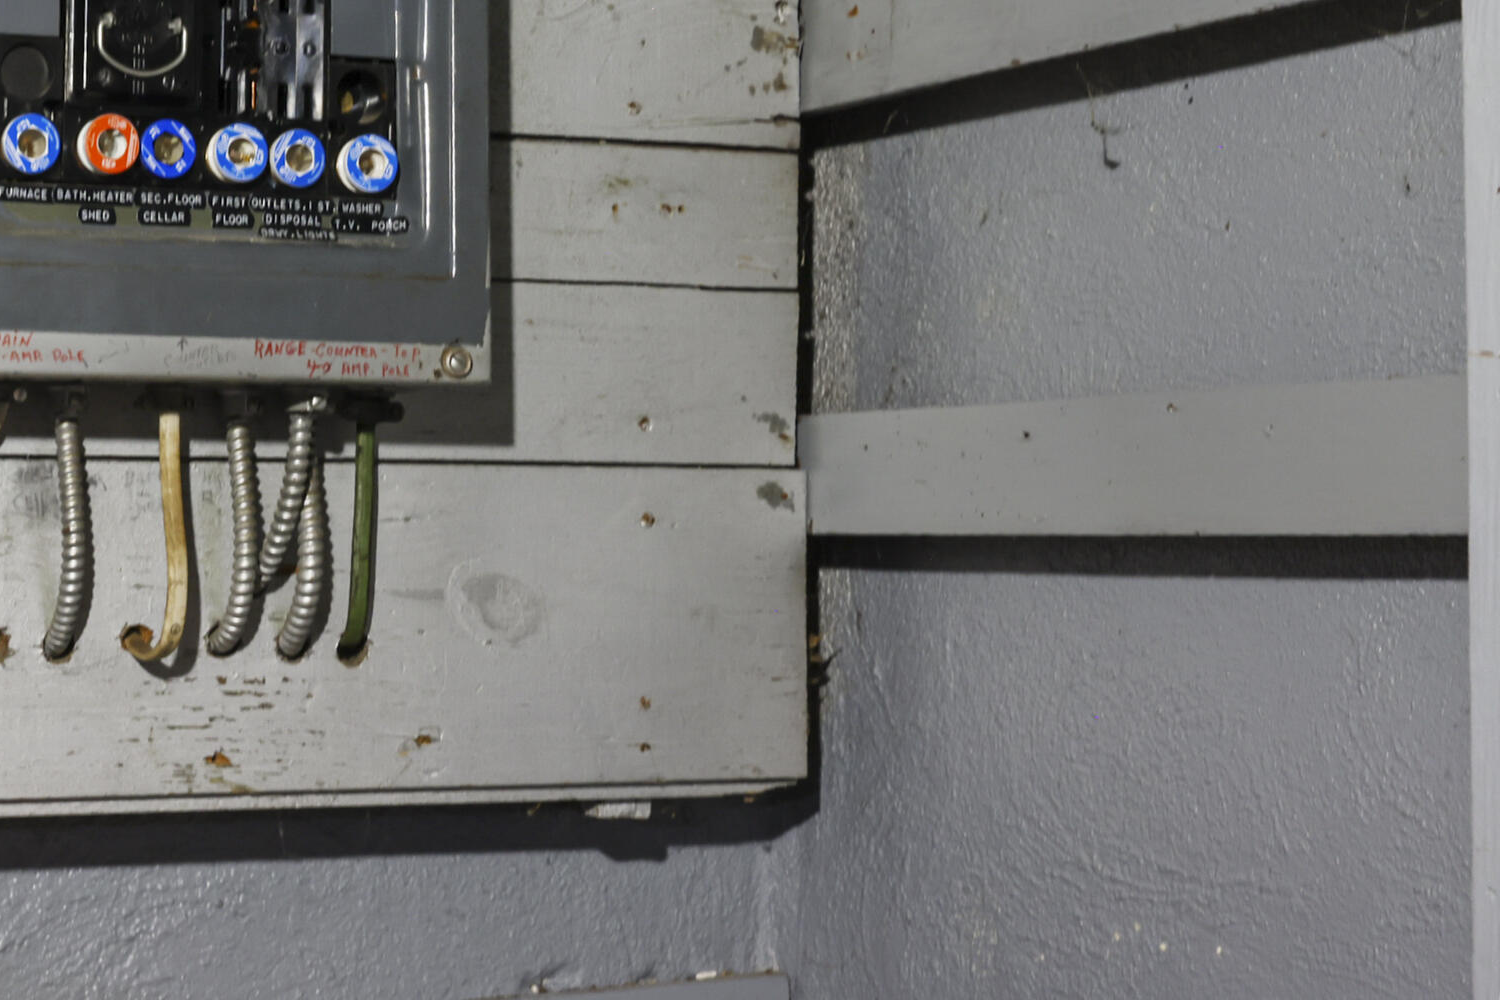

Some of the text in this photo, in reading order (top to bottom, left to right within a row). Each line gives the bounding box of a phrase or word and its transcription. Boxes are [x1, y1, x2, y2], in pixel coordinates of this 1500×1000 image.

[212, 195, 246, 208] FIRST
[342, 201, 382, 214] WASHER
[81, 208, 110, 222] SHED
[143, 211, 185, 223] CELLAR
[215, 213, 249, 226] FLOOR
[265, 213, 321, 227] DISPOSAL
[371, 219, 407, 232] PORCH
[253, 338, 306, 359] RANGE
